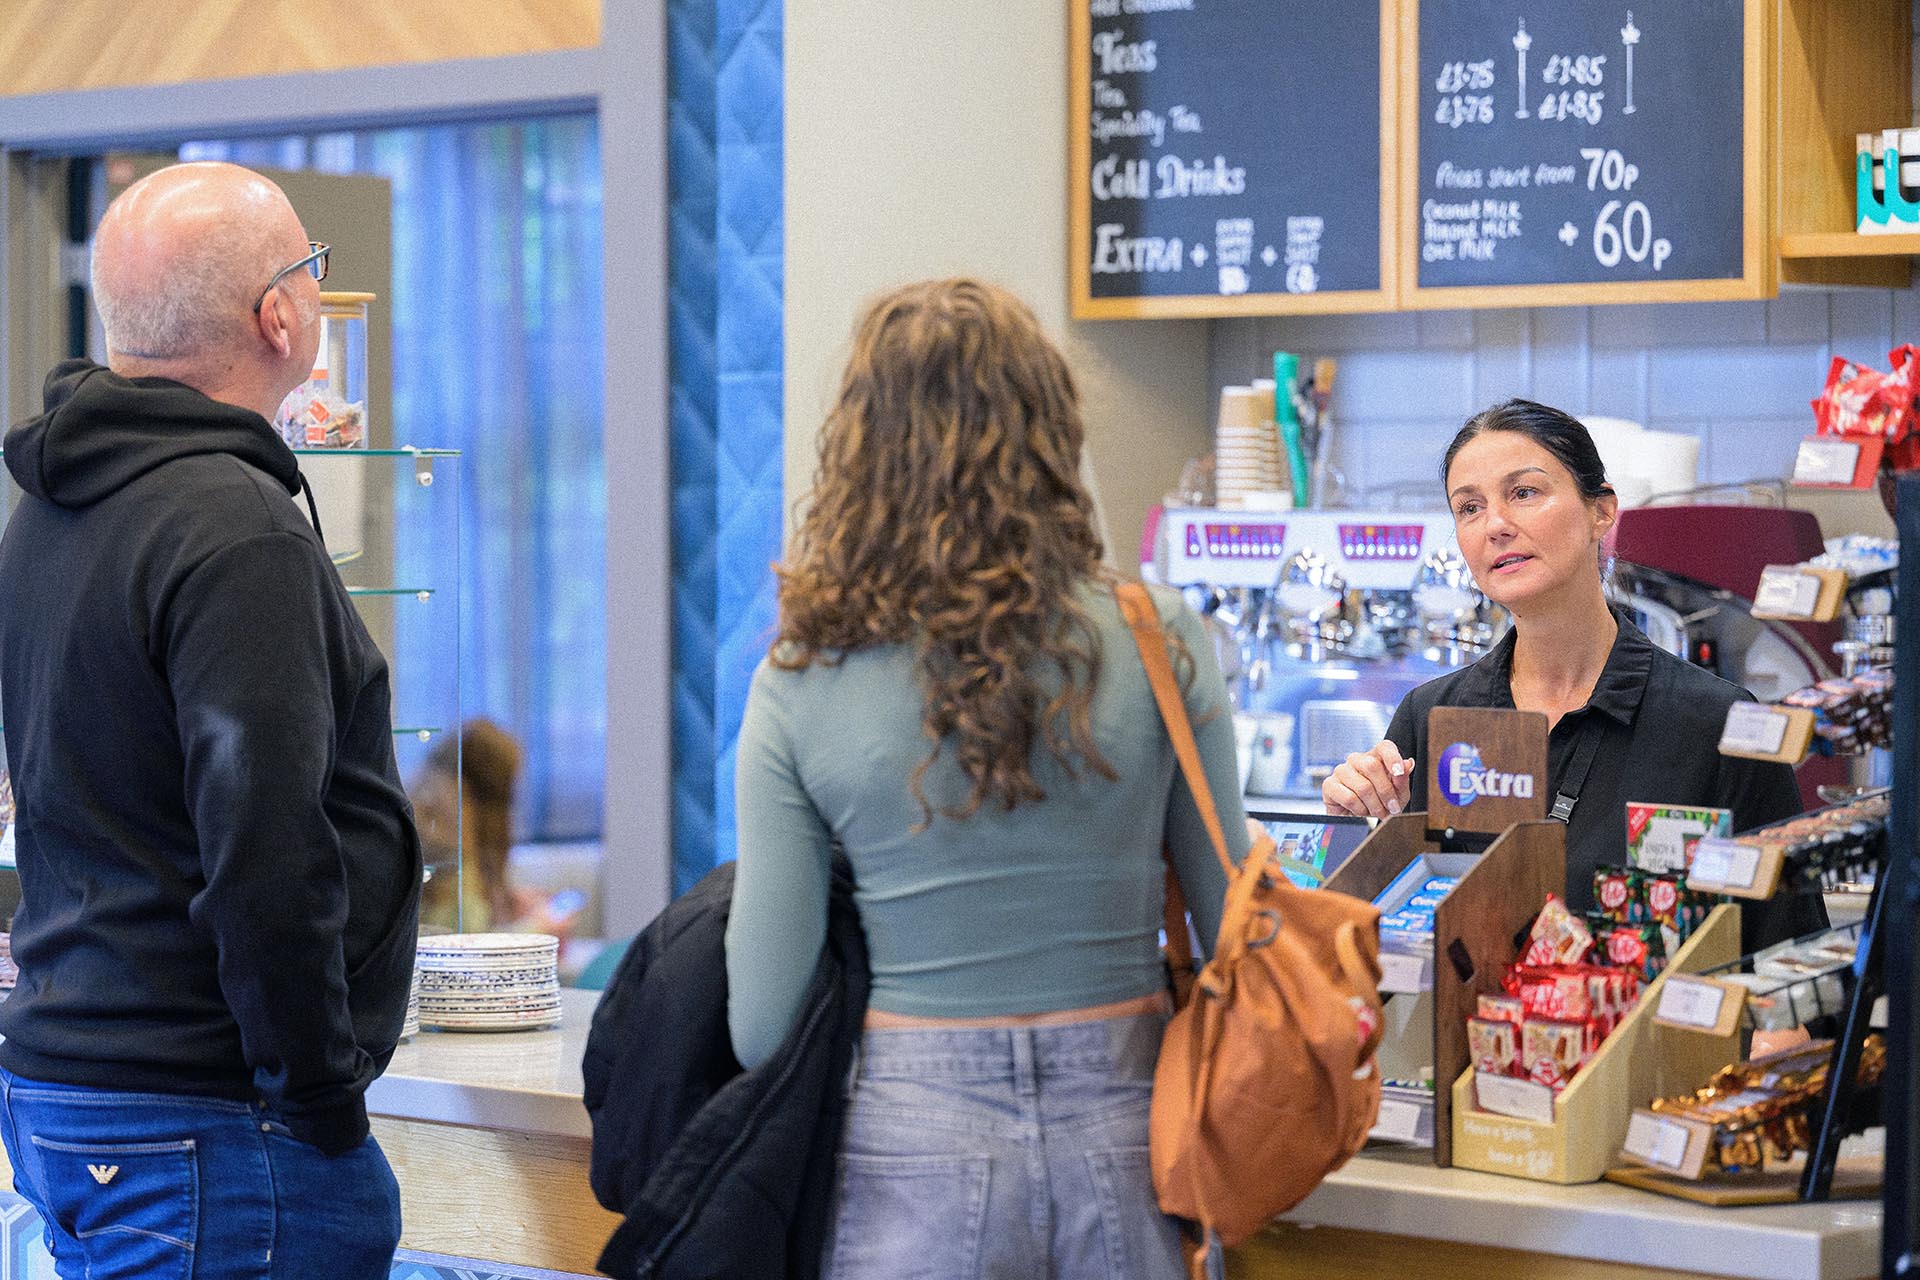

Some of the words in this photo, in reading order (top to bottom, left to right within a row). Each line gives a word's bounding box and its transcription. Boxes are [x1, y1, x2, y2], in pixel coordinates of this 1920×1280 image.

[1093, 29, 1157, 74] Teas
[1091, 153, 1150, 200] Cold
[1154, 154, 1246, 199] Drinks
[1486, 164, 1530, 189] start
[1534, 162, 1576, 187] from
[1579, 147, 1640, 191] 70p
[1593, 199, 1673, 271] 60p
[1449, 756, 1533, 799] Extra
